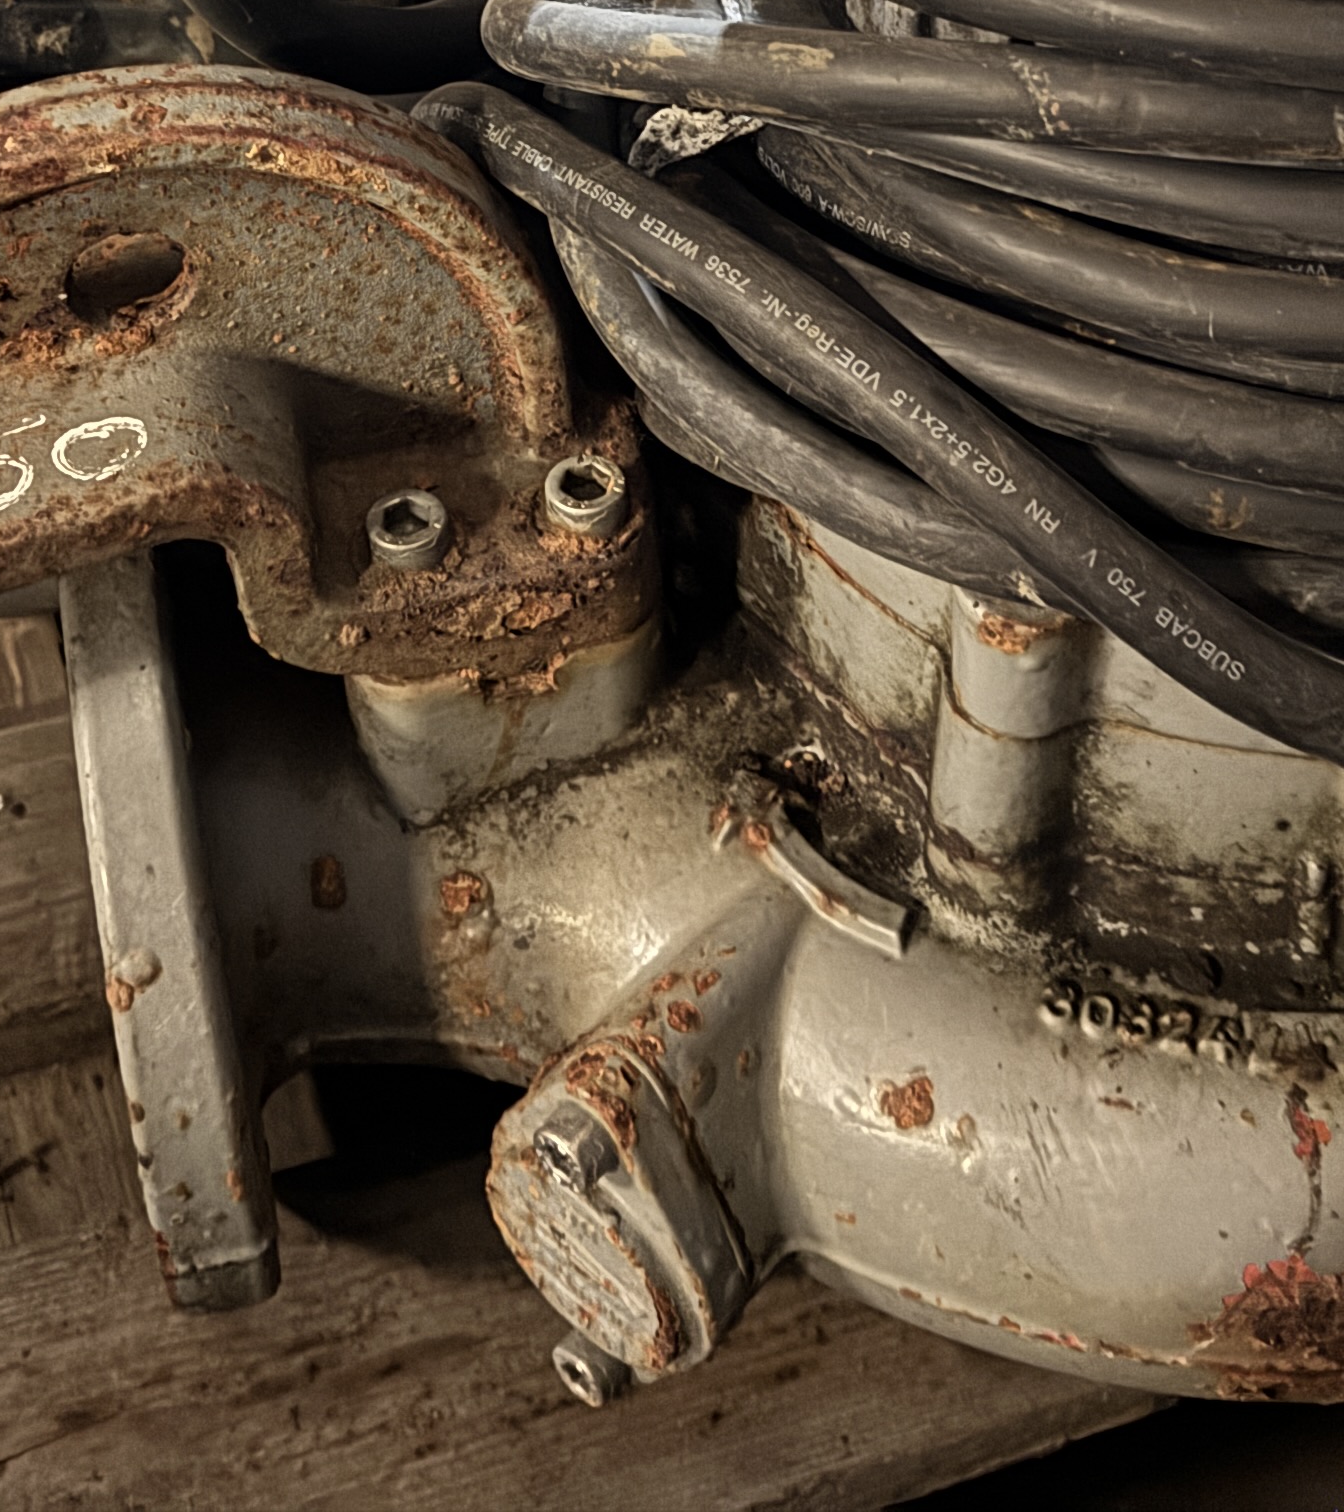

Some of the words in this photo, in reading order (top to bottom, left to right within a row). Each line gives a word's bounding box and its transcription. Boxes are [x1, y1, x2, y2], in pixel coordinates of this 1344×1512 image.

[483, 121, 515, 150] TYPE
[512, 140, 554, 172] CABLE
[553, 166, 637, 220] RESISTANT
[639, 212, 700, 261] WATER
[704, 254, 752, 295] 7536
[1023, 498, 1061, 535] RN
[1079, 548, 1098, 569] V
[1107, 568, 1148, 608] 750
[1154, 605, 1247, 682] SUBCAB
